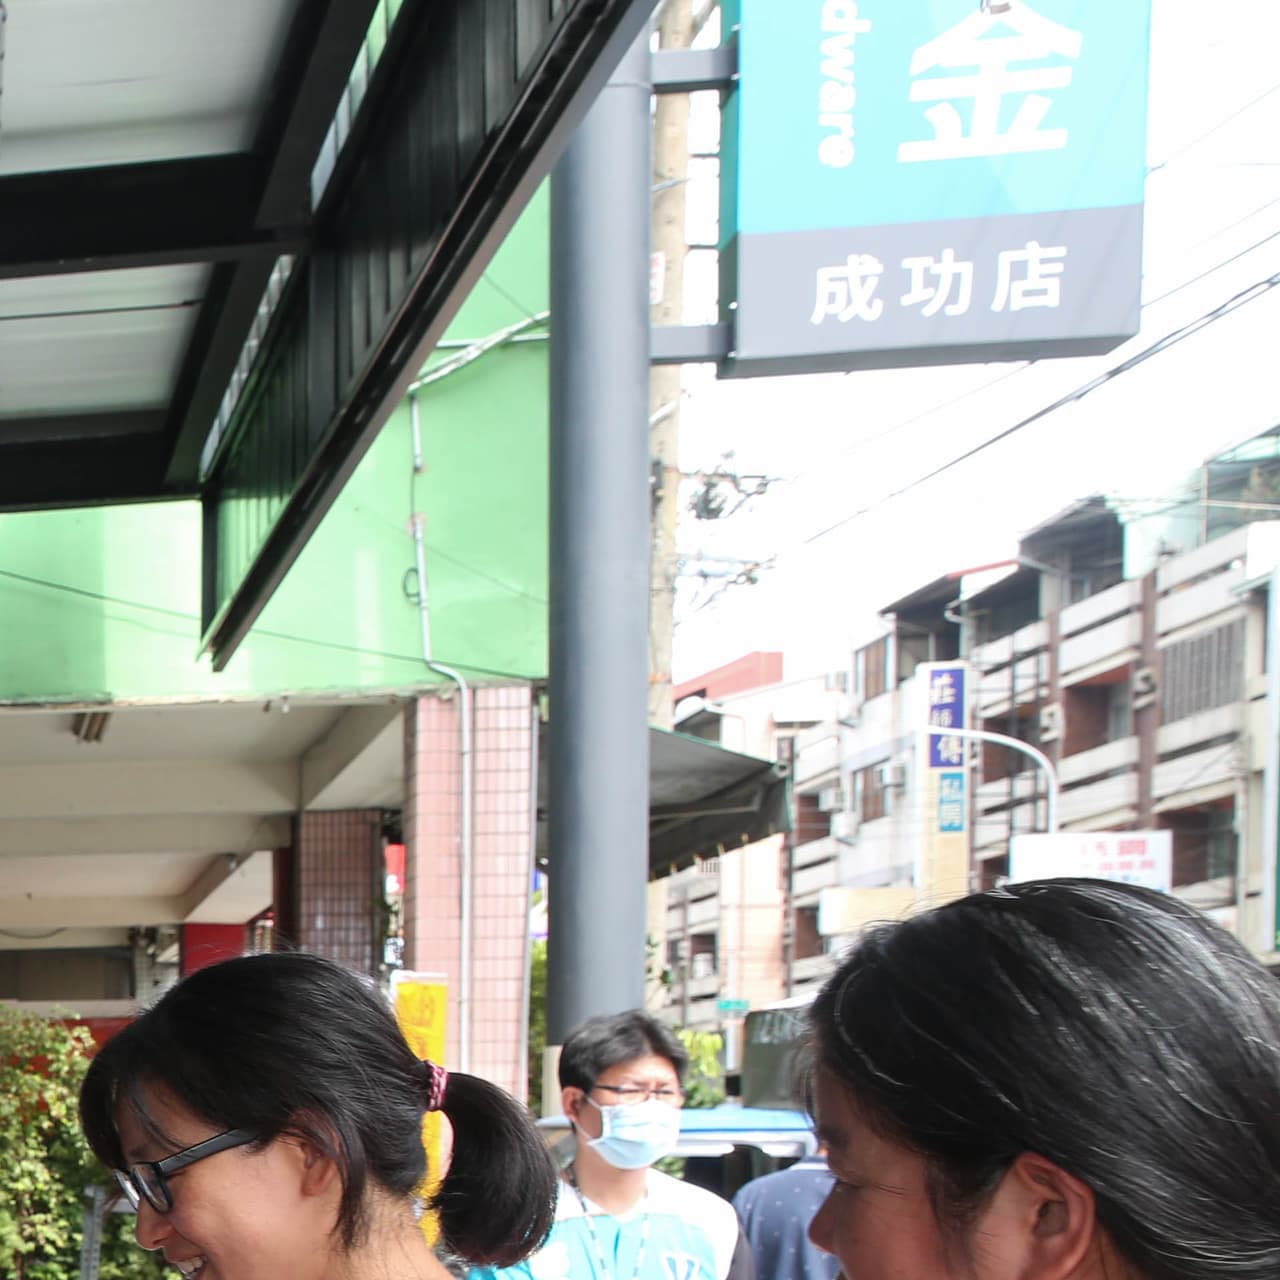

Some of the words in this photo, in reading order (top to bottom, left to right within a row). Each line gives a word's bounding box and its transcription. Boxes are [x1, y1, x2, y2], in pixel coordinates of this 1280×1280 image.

[896, 0, 1083, 164] 金
[809, 241, 1068, 326] 成功店
